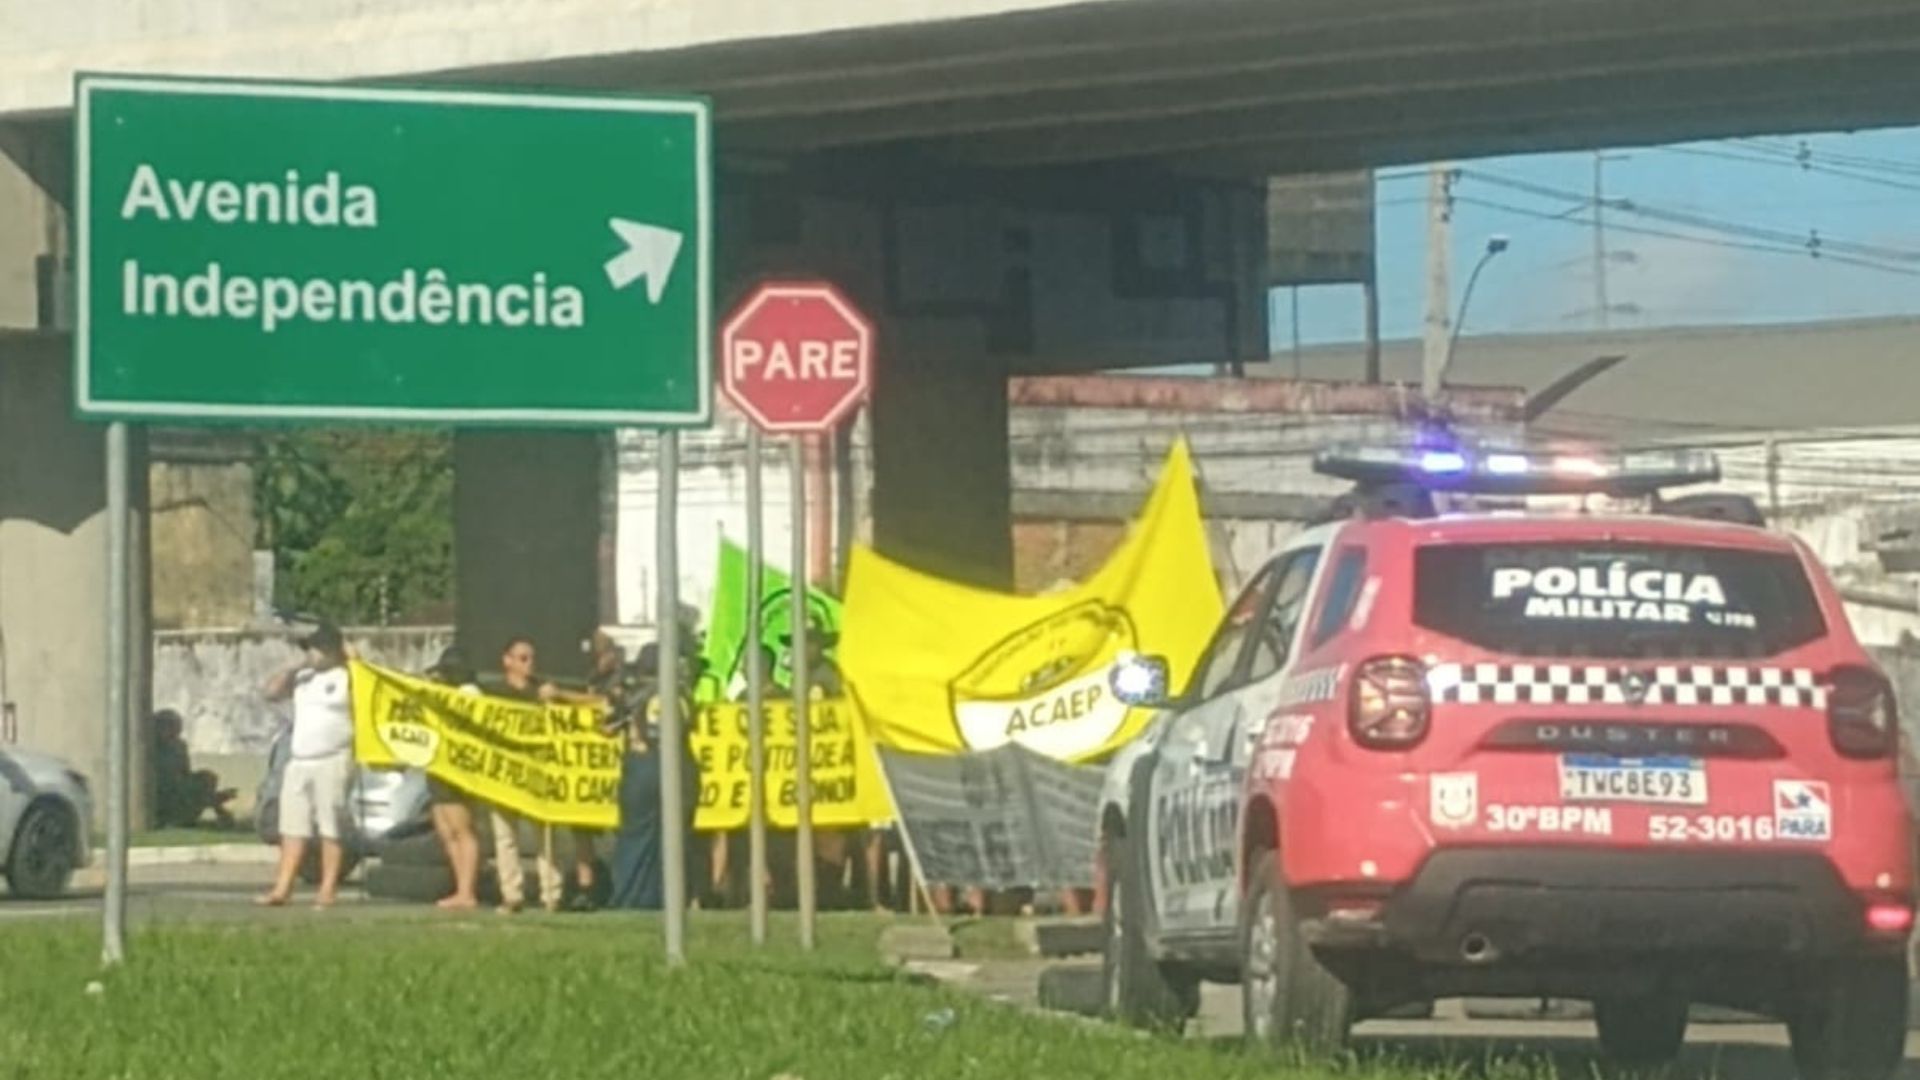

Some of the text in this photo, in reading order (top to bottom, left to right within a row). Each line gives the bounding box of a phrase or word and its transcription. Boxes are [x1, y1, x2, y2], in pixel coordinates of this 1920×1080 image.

[121, 164, 378, 228] Avenida
[121, 259, 584, 332] Independência
[733, 340, 860, 380] PARE
[1492, 560, 1726, 605] POLÍCIA
[1523, 596, 1690, 624] MILITAR
[1005, 684, 1103, 737] ACAEP
[1536, 725, 1729, 745] DUSTER
[1578, 770, 1692, 798] TWC8E93
[1648, 814, 1774, 840] 52-3016
